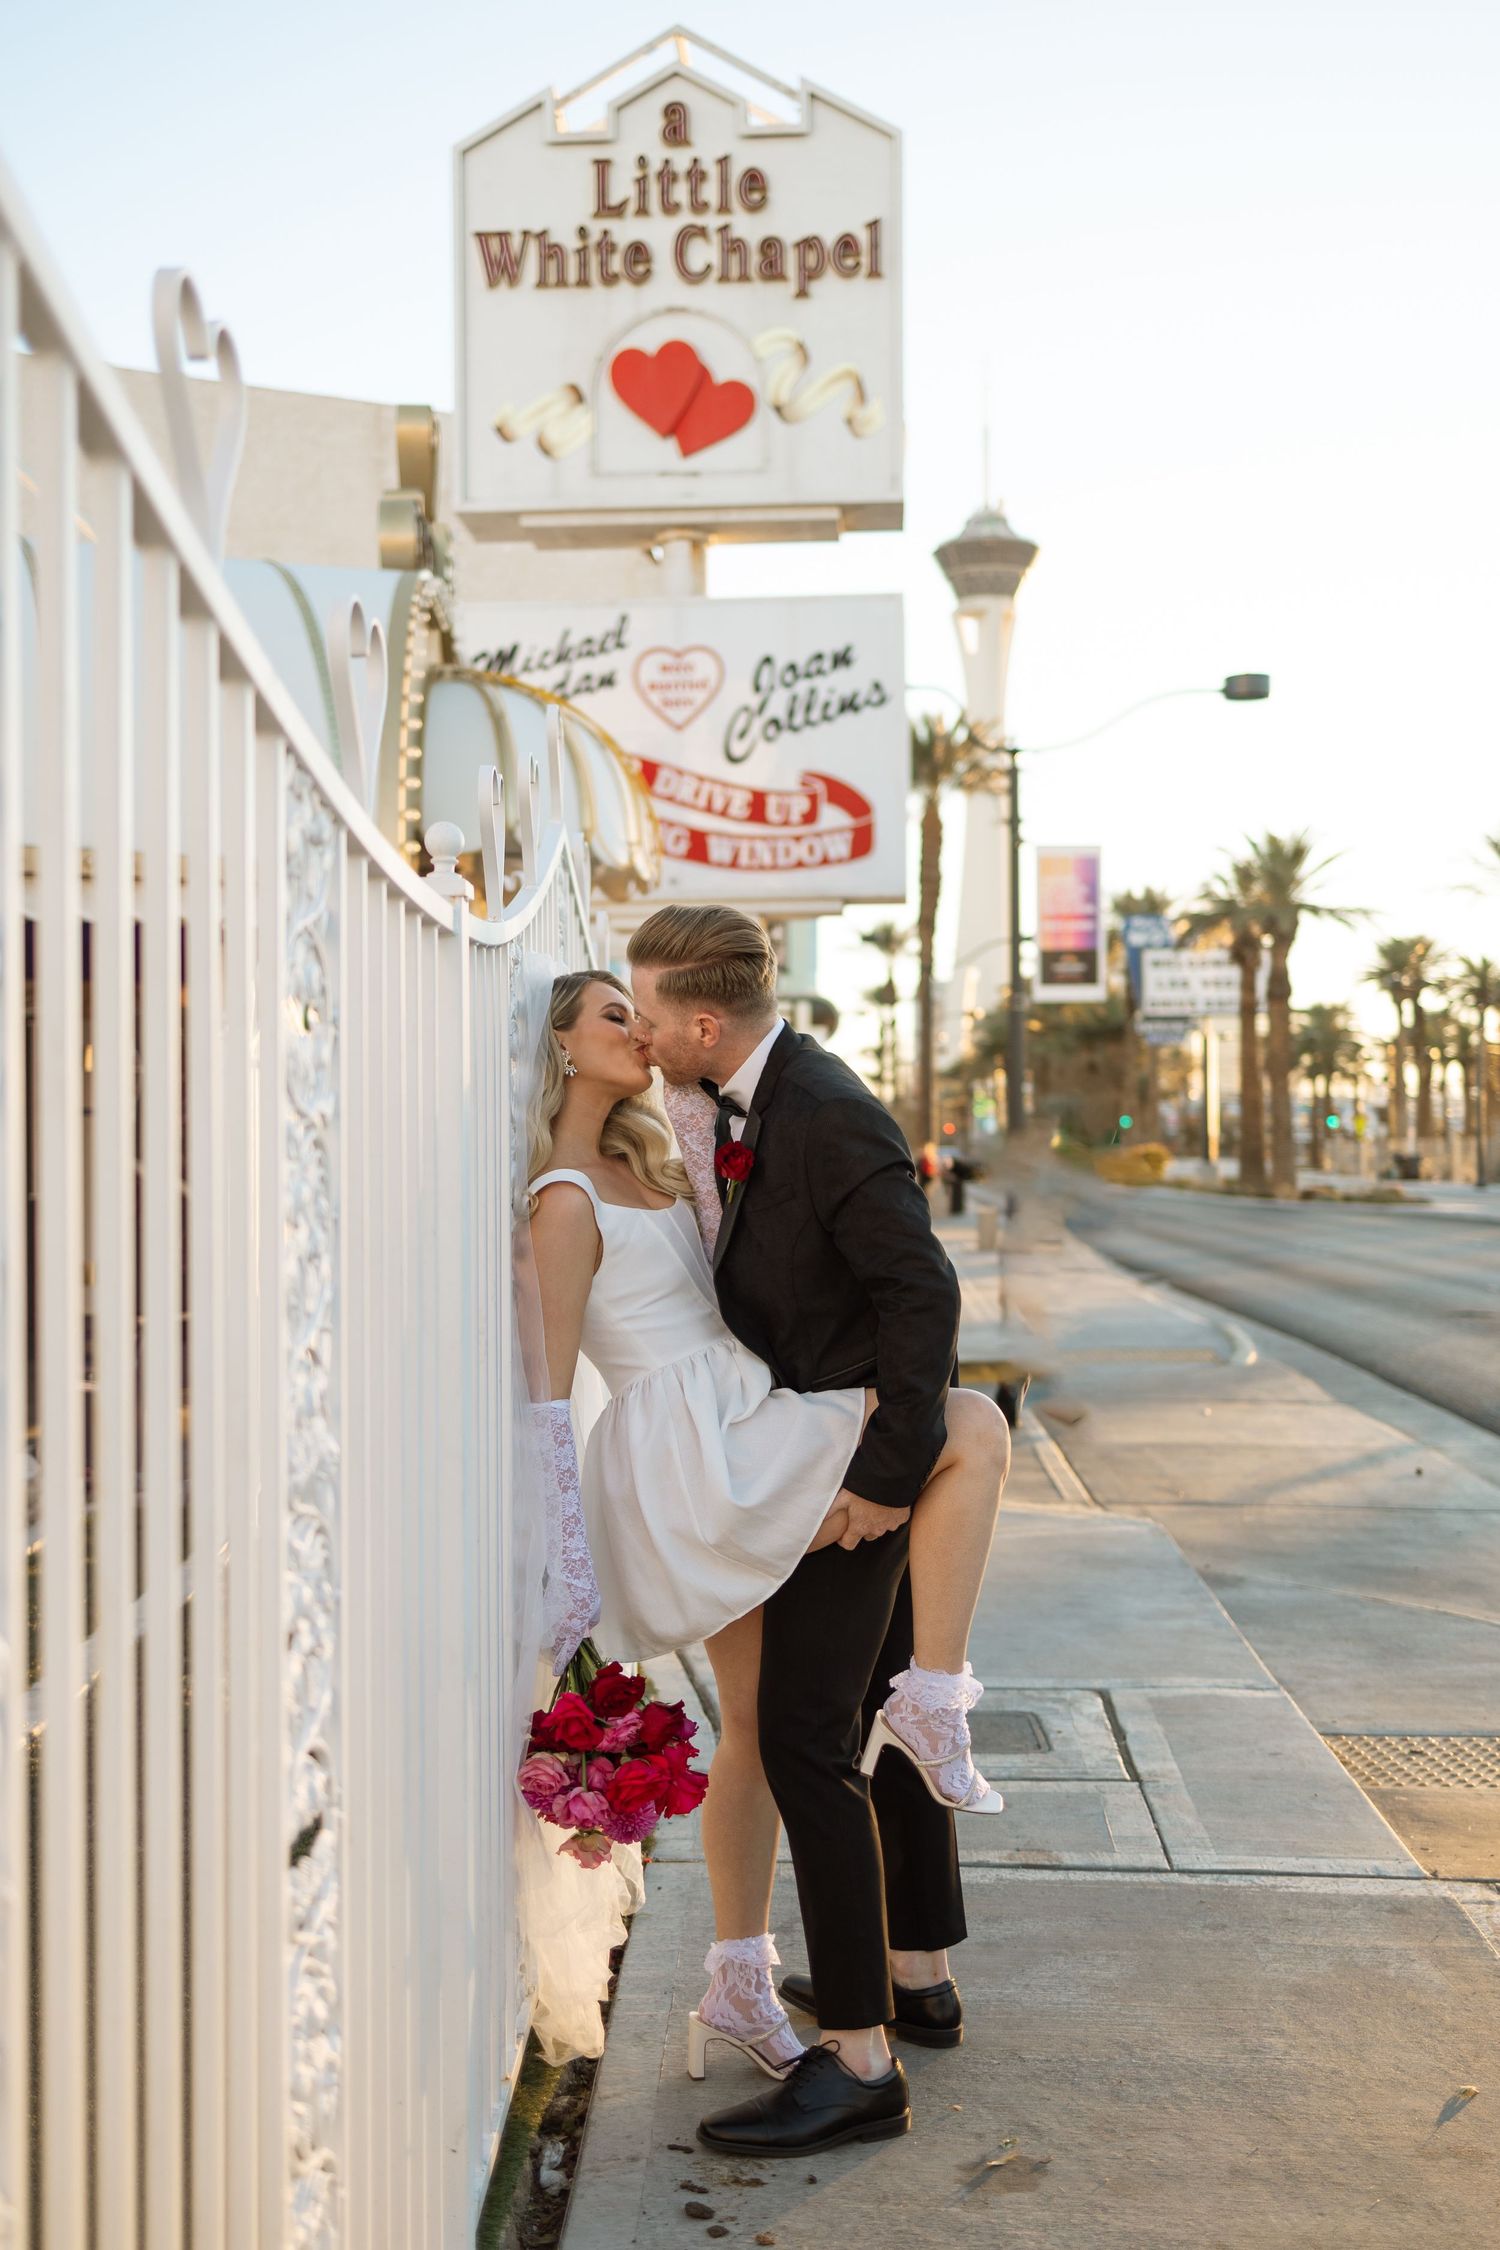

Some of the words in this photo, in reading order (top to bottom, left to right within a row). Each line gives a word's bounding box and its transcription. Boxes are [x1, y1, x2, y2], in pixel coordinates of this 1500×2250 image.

[661, 101, 690, 146] a
[592, 155, 769, 218] Little
[474, 226, 653, 288] White
[674, 218, 884, 299] Chapel
[472, 612, 630, 673] Michael
[551, 670, 618, 700] dan
[752, 643, 855, 717] Joan
[722, 680, 890, 764] Collins
[653, 765, 754, 818] DRIVE
[764, 792, 812, 823] UP
[705, 832, 855, 868] WINDOW
